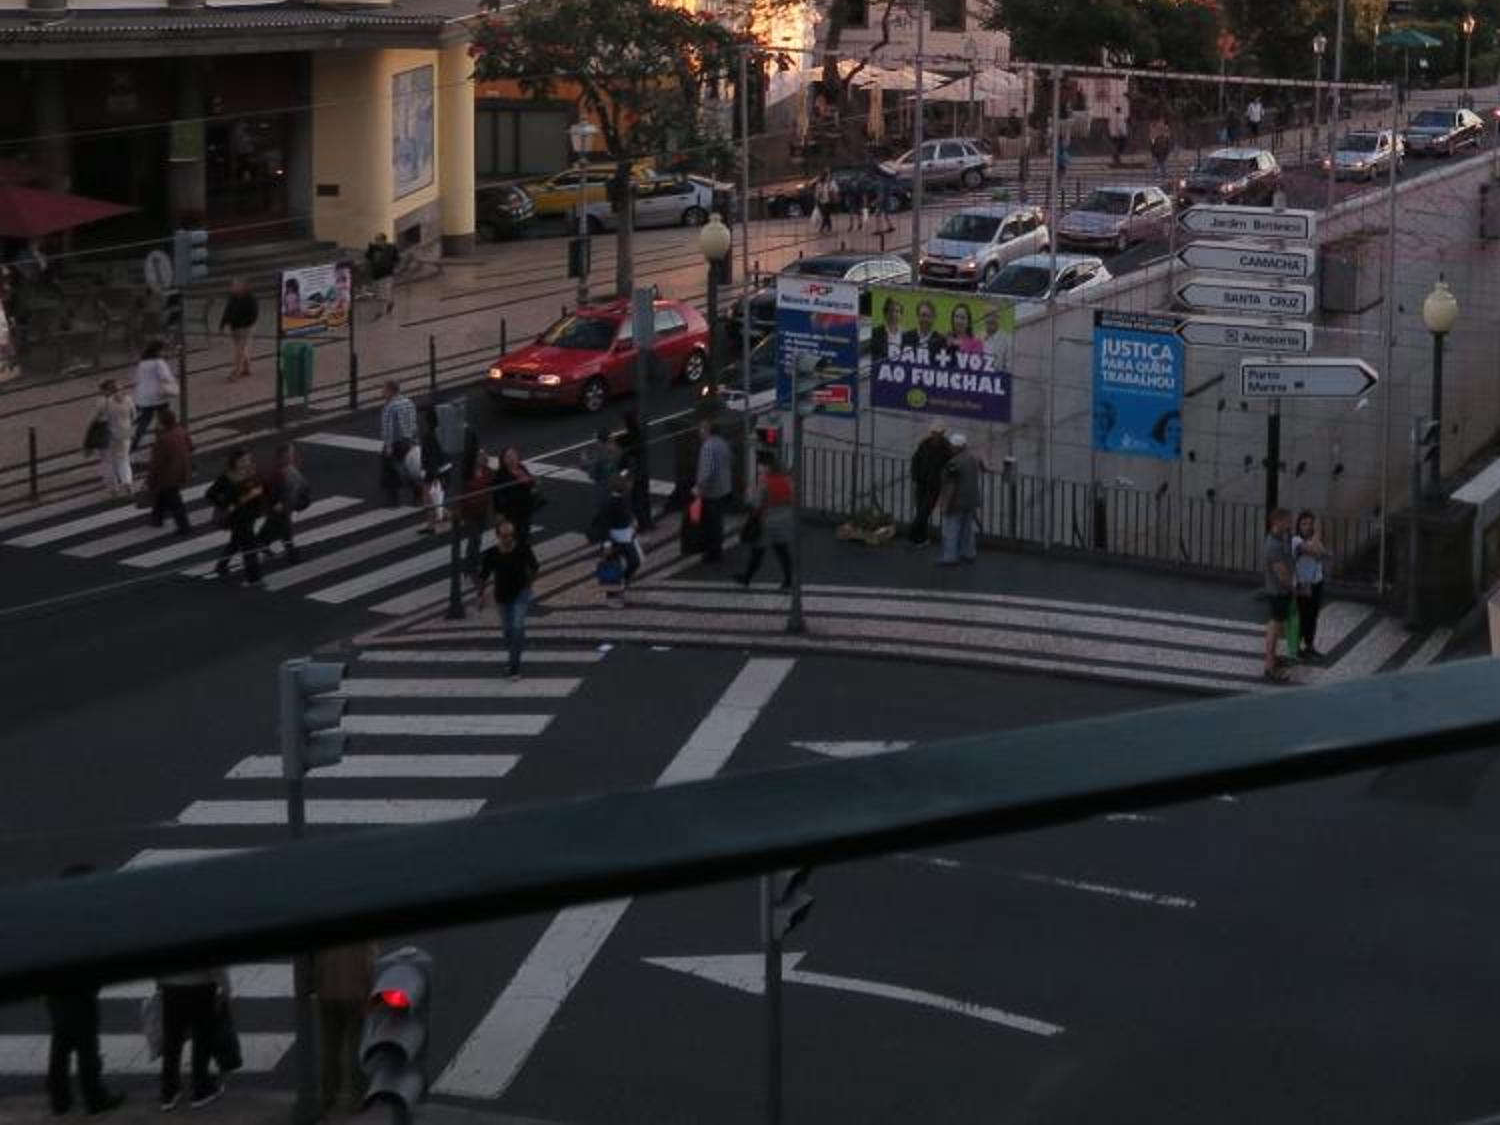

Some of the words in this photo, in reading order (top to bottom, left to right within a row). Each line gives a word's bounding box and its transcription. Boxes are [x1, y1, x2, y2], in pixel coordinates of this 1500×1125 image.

[1239, 256, 1301, 271] CAMACHA
[1223, 292, 1261, 306] SANTA
[1269, 296, 1299, 309] CRUZ
[1241, 332, 1299, 347] Aeroporto
[955, 351, 996, 373] VOZ
[1102, 356, 1135, 371] PARA
[877, 363, 906, 383] AO
[911, 367, 1005, 395] FUNCHAL
